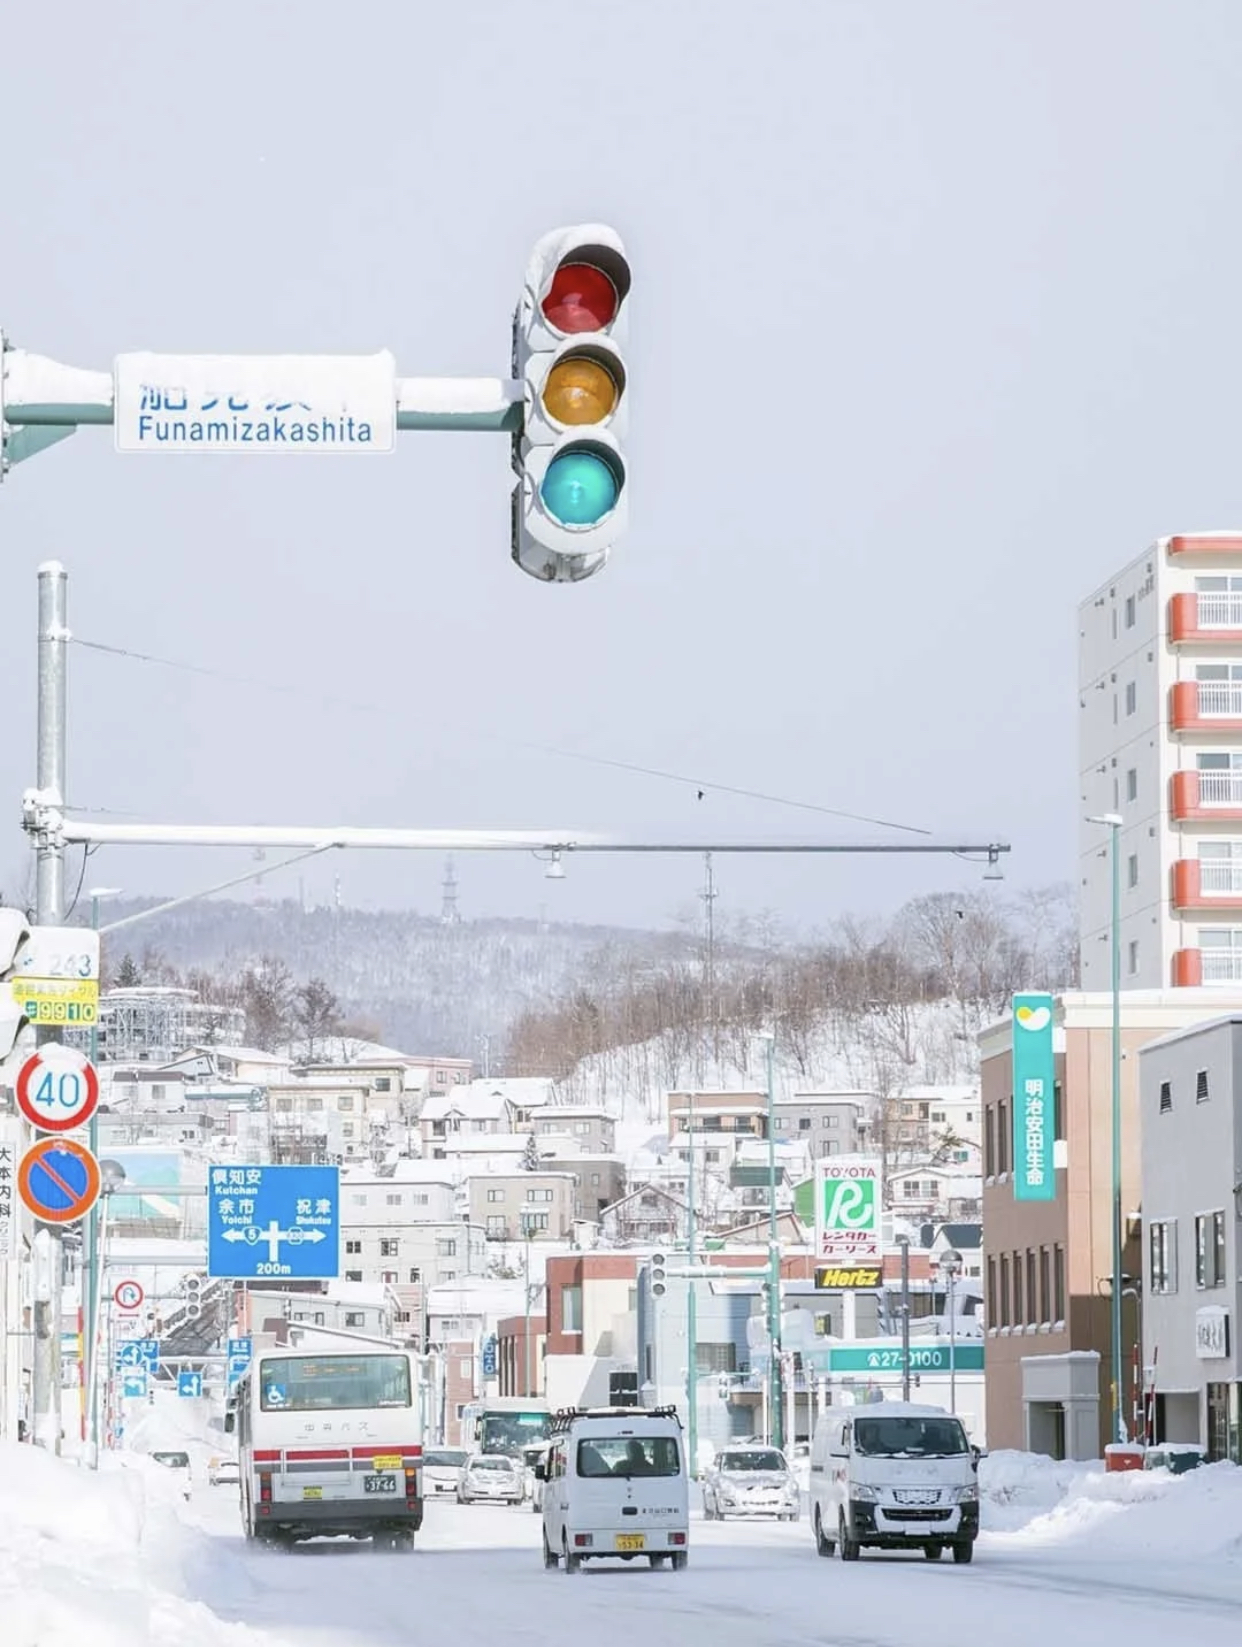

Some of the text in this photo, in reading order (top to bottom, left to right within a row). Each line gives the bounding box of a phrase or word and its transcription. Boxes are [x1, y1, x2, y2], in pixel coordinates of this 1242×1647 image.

[139, 415, 372, 442] Funamizakashita
[36, 1072, 79, 1107] 40
[1025, 1079, 1044, 1185] 明治安田生命
[823, 1167, 876, 1178] TOYOTA
[214, 1186, 259, 1195] Kutchan
[218, 1198, 255, 1215] 余市
[221, 1216, 253, 1225] Yoichi
[247, 1229, 257, 1240] 5
[823, 1231, 877, 1241] レンタカー
[823, 1244, 877, 1254] カーリース
[256, 1262, 292, 1275] 200m
[822, 1268, 879, 1287] Hertz
